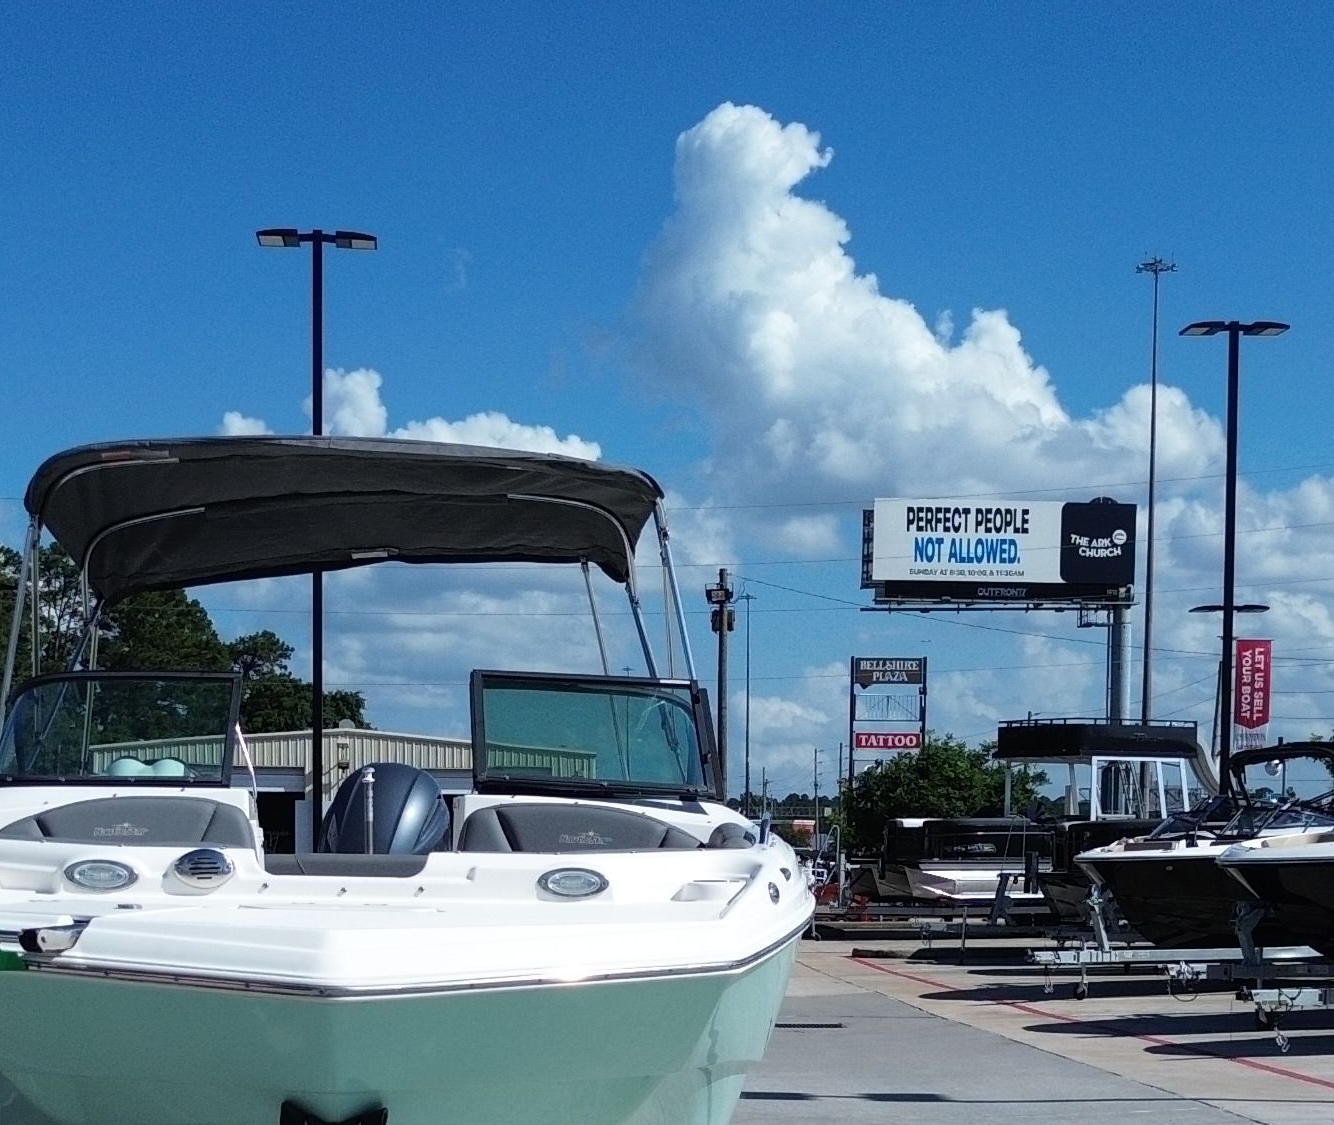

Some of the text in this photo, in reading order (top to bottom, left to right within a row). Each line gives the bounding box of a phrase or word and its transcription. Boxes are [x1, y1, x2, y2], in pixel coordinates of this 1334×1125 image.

[906, 506, 1029, 534] PERFECT PEOPLE
[1070, 533, 1112, 548] THE ARK
[914, 536, 1020, 564] NOT ALLOWED.
[1078, 546, 1122, 558] CHURCH
[909, 568, 937, 576] SUNDAY
[860, 661, 919, 671] BELLSHIRE
[872, 671, 908, 682] PLAZA
[1241, 649, 1252, 718] YOUR BOAT
[1253, 647, 1265, 721] LET US SELL
[859, 735, 917, 747] TATTOO
